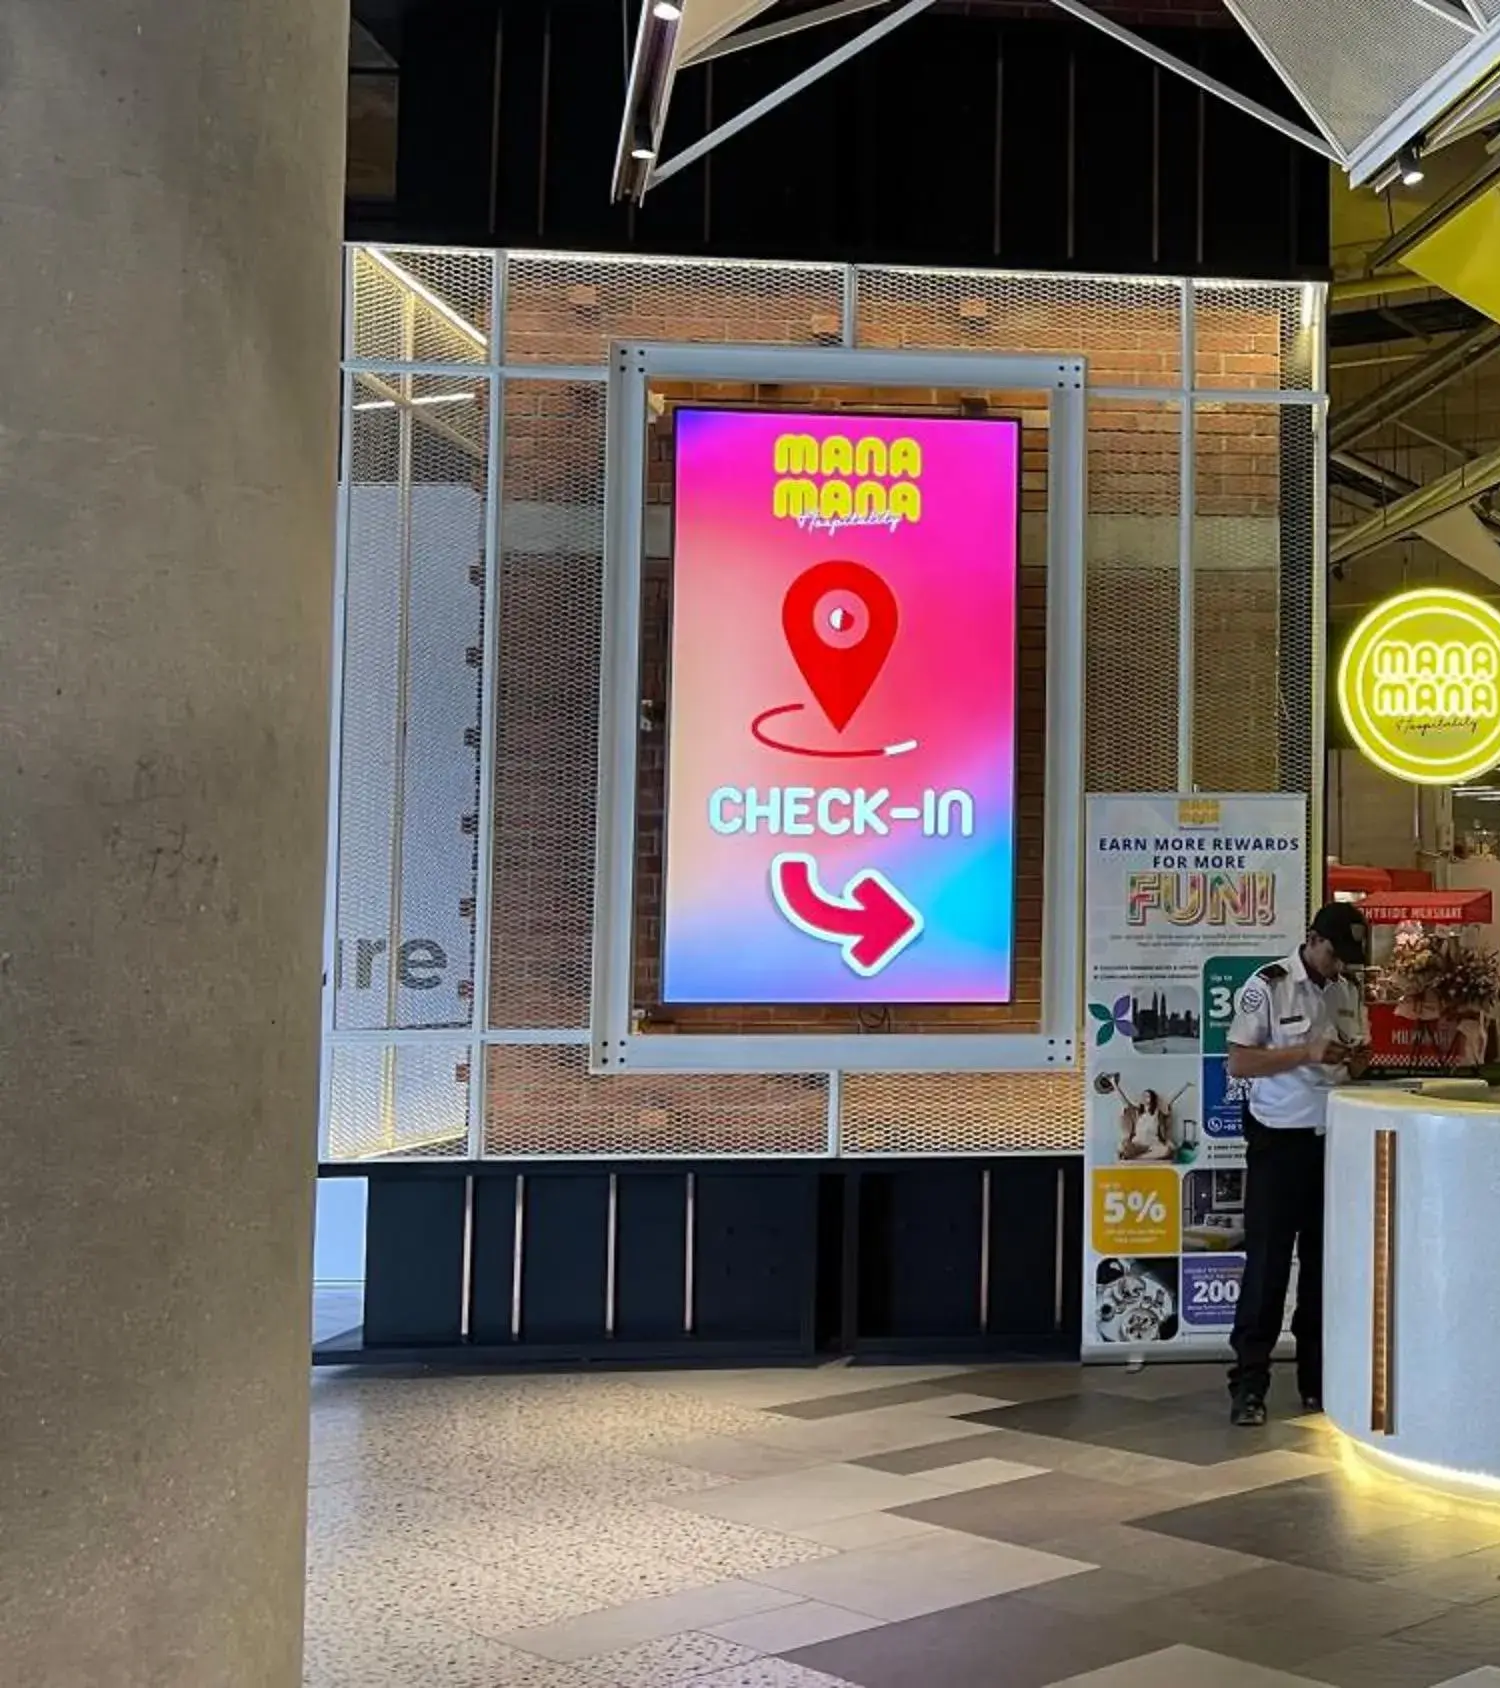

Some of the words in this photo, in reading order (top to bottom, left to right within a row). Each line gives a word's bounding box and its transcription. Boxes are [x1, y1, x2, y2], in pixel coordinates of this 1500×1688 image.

[774, 433, 922, 478] MANA
[773, 478, 922, 523] MANA
[796, 510, 901, 537] Hospitality
[1373, 640, 1498, 679] MANA
[1373, 679, 1498, 718] MANA
[707, 785, 974, 837] CHECK-IN
[1099, 838, 1147, 851] EARN
[1154, 838, 1205, 851] MORE
[1212, 838, 1300, 851] REWARDS
[1153, 855, 1188, 869] FOR
[1194, 855, 1246, 869] MORE
[1125, 871, 1276, 926] FUN!
[1103, 1190, 1167, 1223] 5%
[1193, 1279, 1241, 1303] 200
